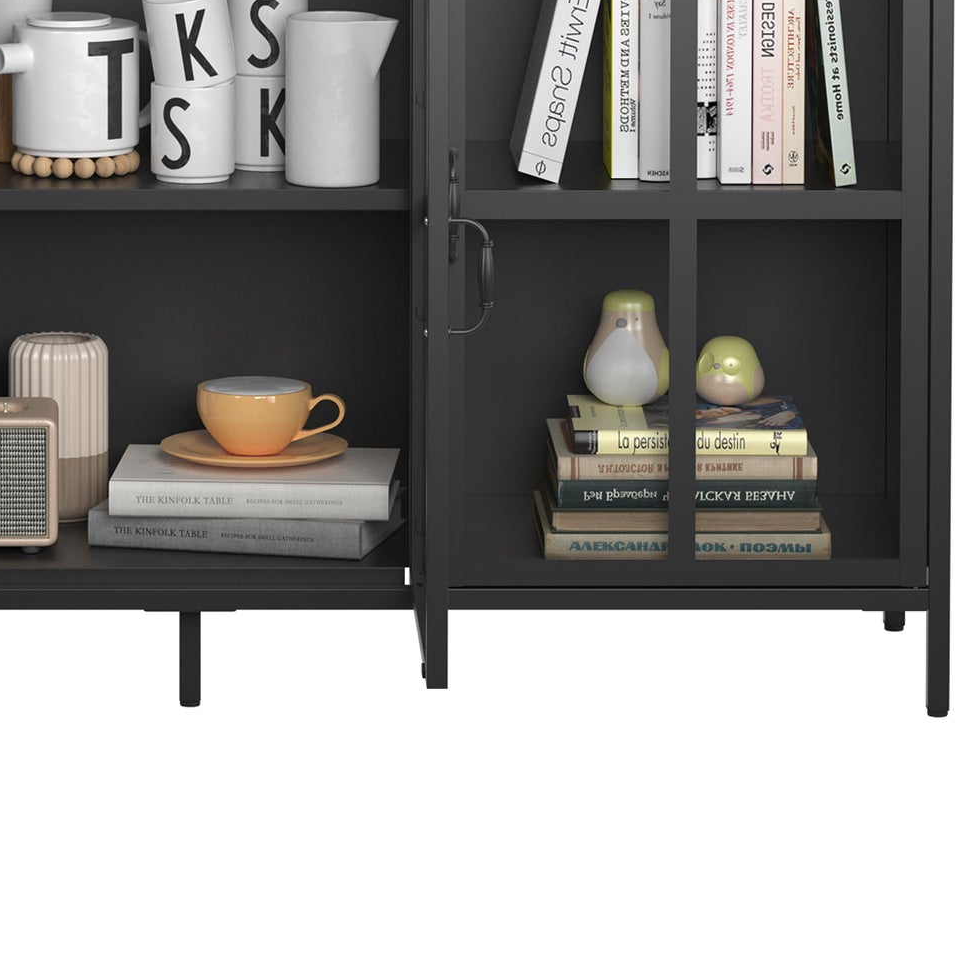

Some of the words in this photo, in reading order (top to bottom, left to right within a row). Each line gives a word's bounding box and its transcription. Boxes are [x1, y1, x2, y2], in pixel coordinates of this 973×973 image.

[175, 9, 218, 82] K
[88, 38, 134, 140] T
[161, 97, 191, 170] S
[260, 88, 285, 157] K
[618, 431, 630, 449] La
[633, 431, 669, 454] persist
[697, 431, 710, 449] du
[714, 431, 746, 449] destin
[135, 495, 155, 504] THE
[157, 496, 201, 505] KINFOLK
[203, 497, 233, 506] TABLE
[114, 526, 134, 535] THE
[135, 527, 176, 537] KINFOLK
[178, 529, 208, 538] TABLE
[276, 535, 315, 543] GATHERINGS
[739, 543, 812, 553] ПОЭМЫ
